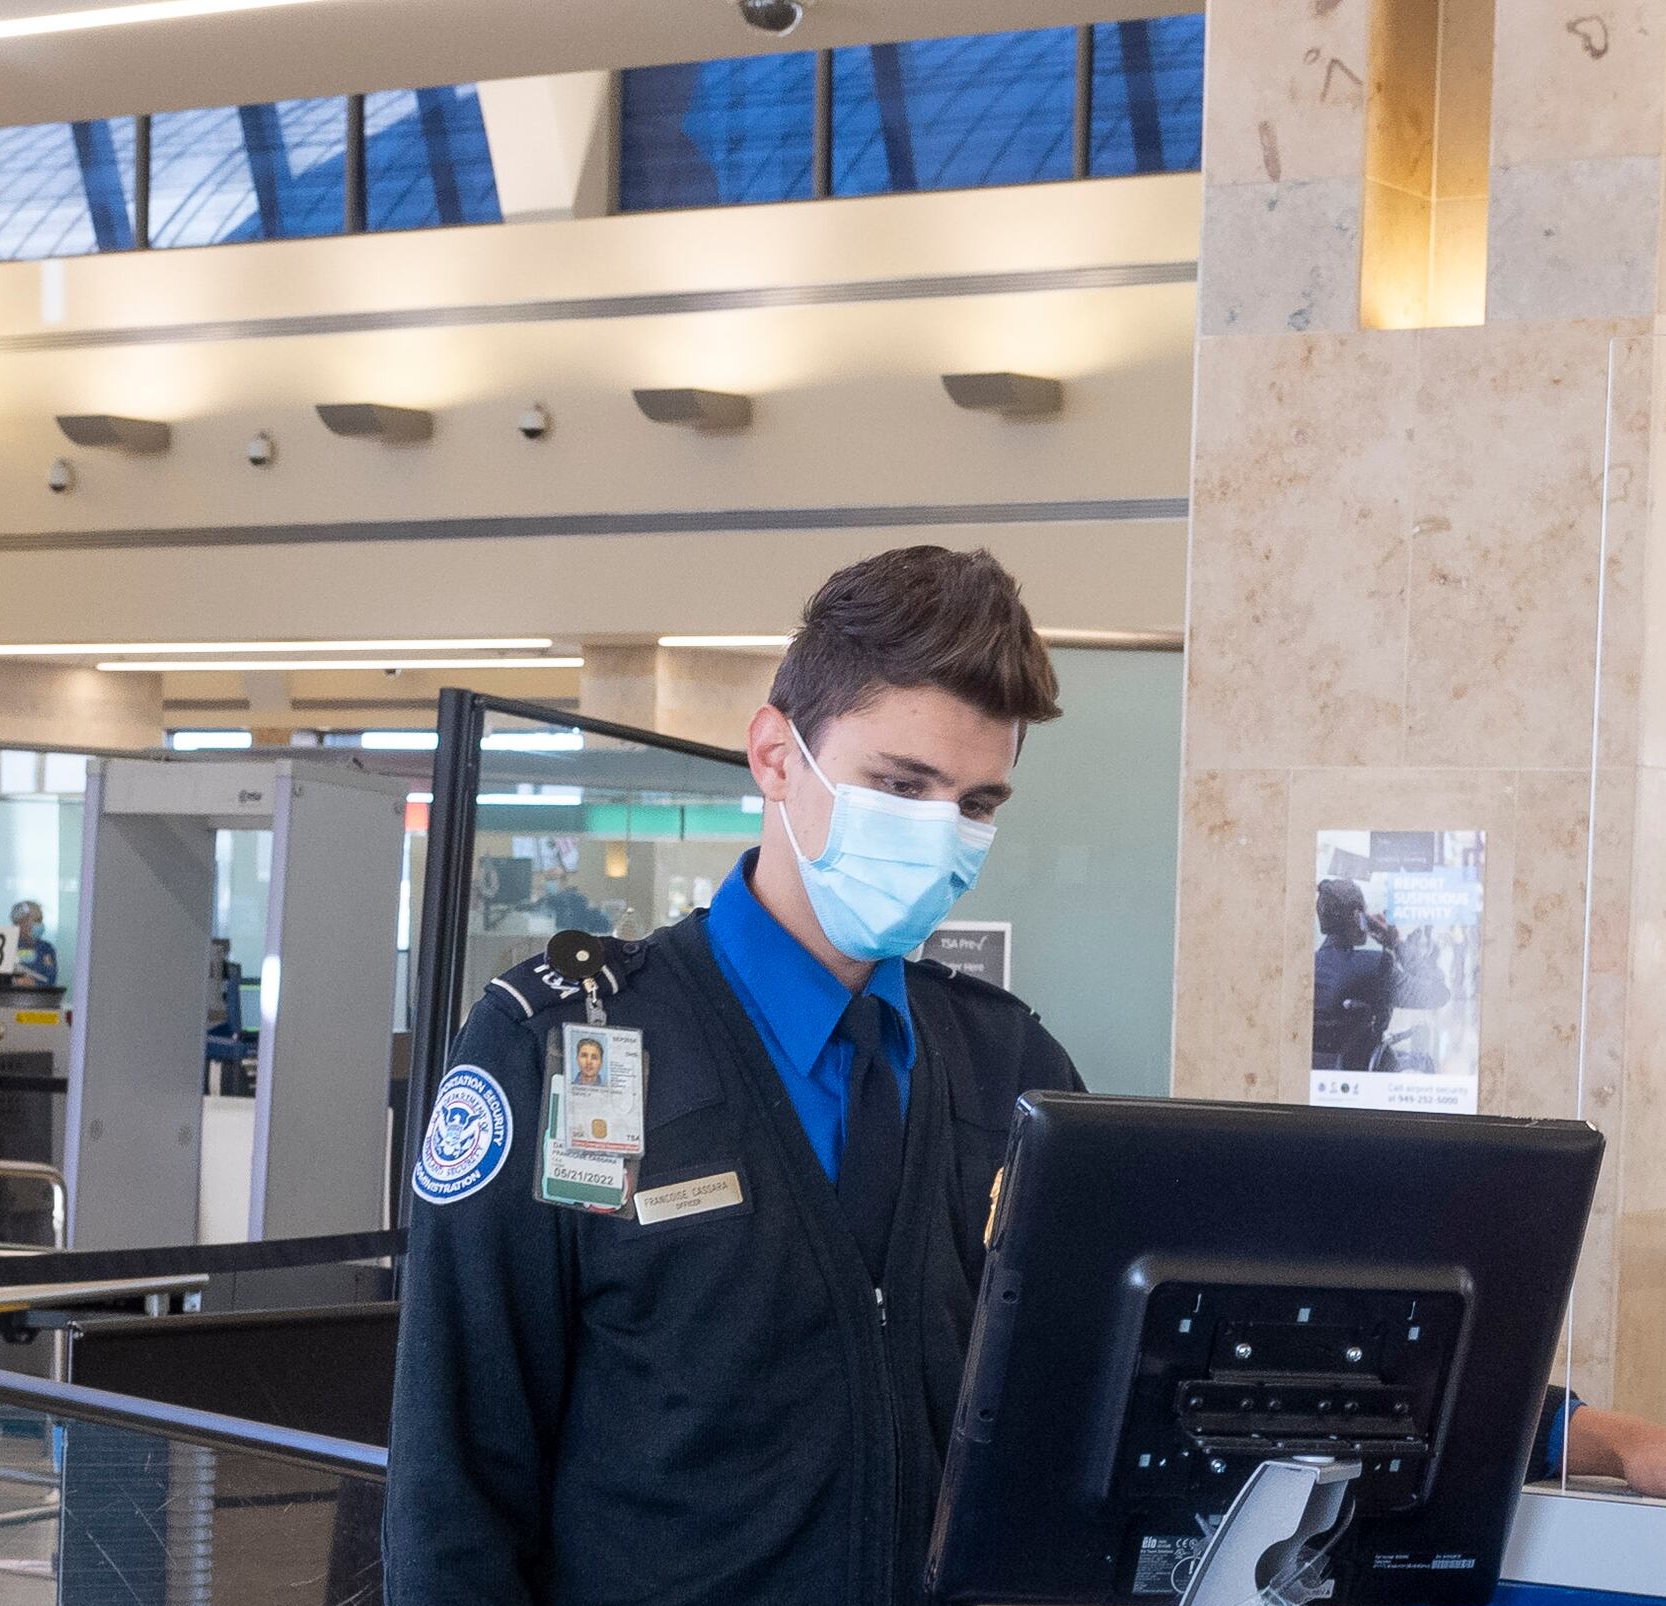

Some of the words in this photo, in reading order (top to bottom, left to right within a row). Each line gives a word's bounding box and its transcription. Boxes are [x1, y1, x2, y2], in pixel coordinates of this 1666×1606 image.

[484, 1088, 504, 1147] SECURITY
[553, 1167, 614, 1186] 05/21/2022
[644, 1190, 687, 1207] FRANCOISE
[692, 1181, 729, 1197] CASSARA
[675, 1199, 702, 1211] OFFICER
